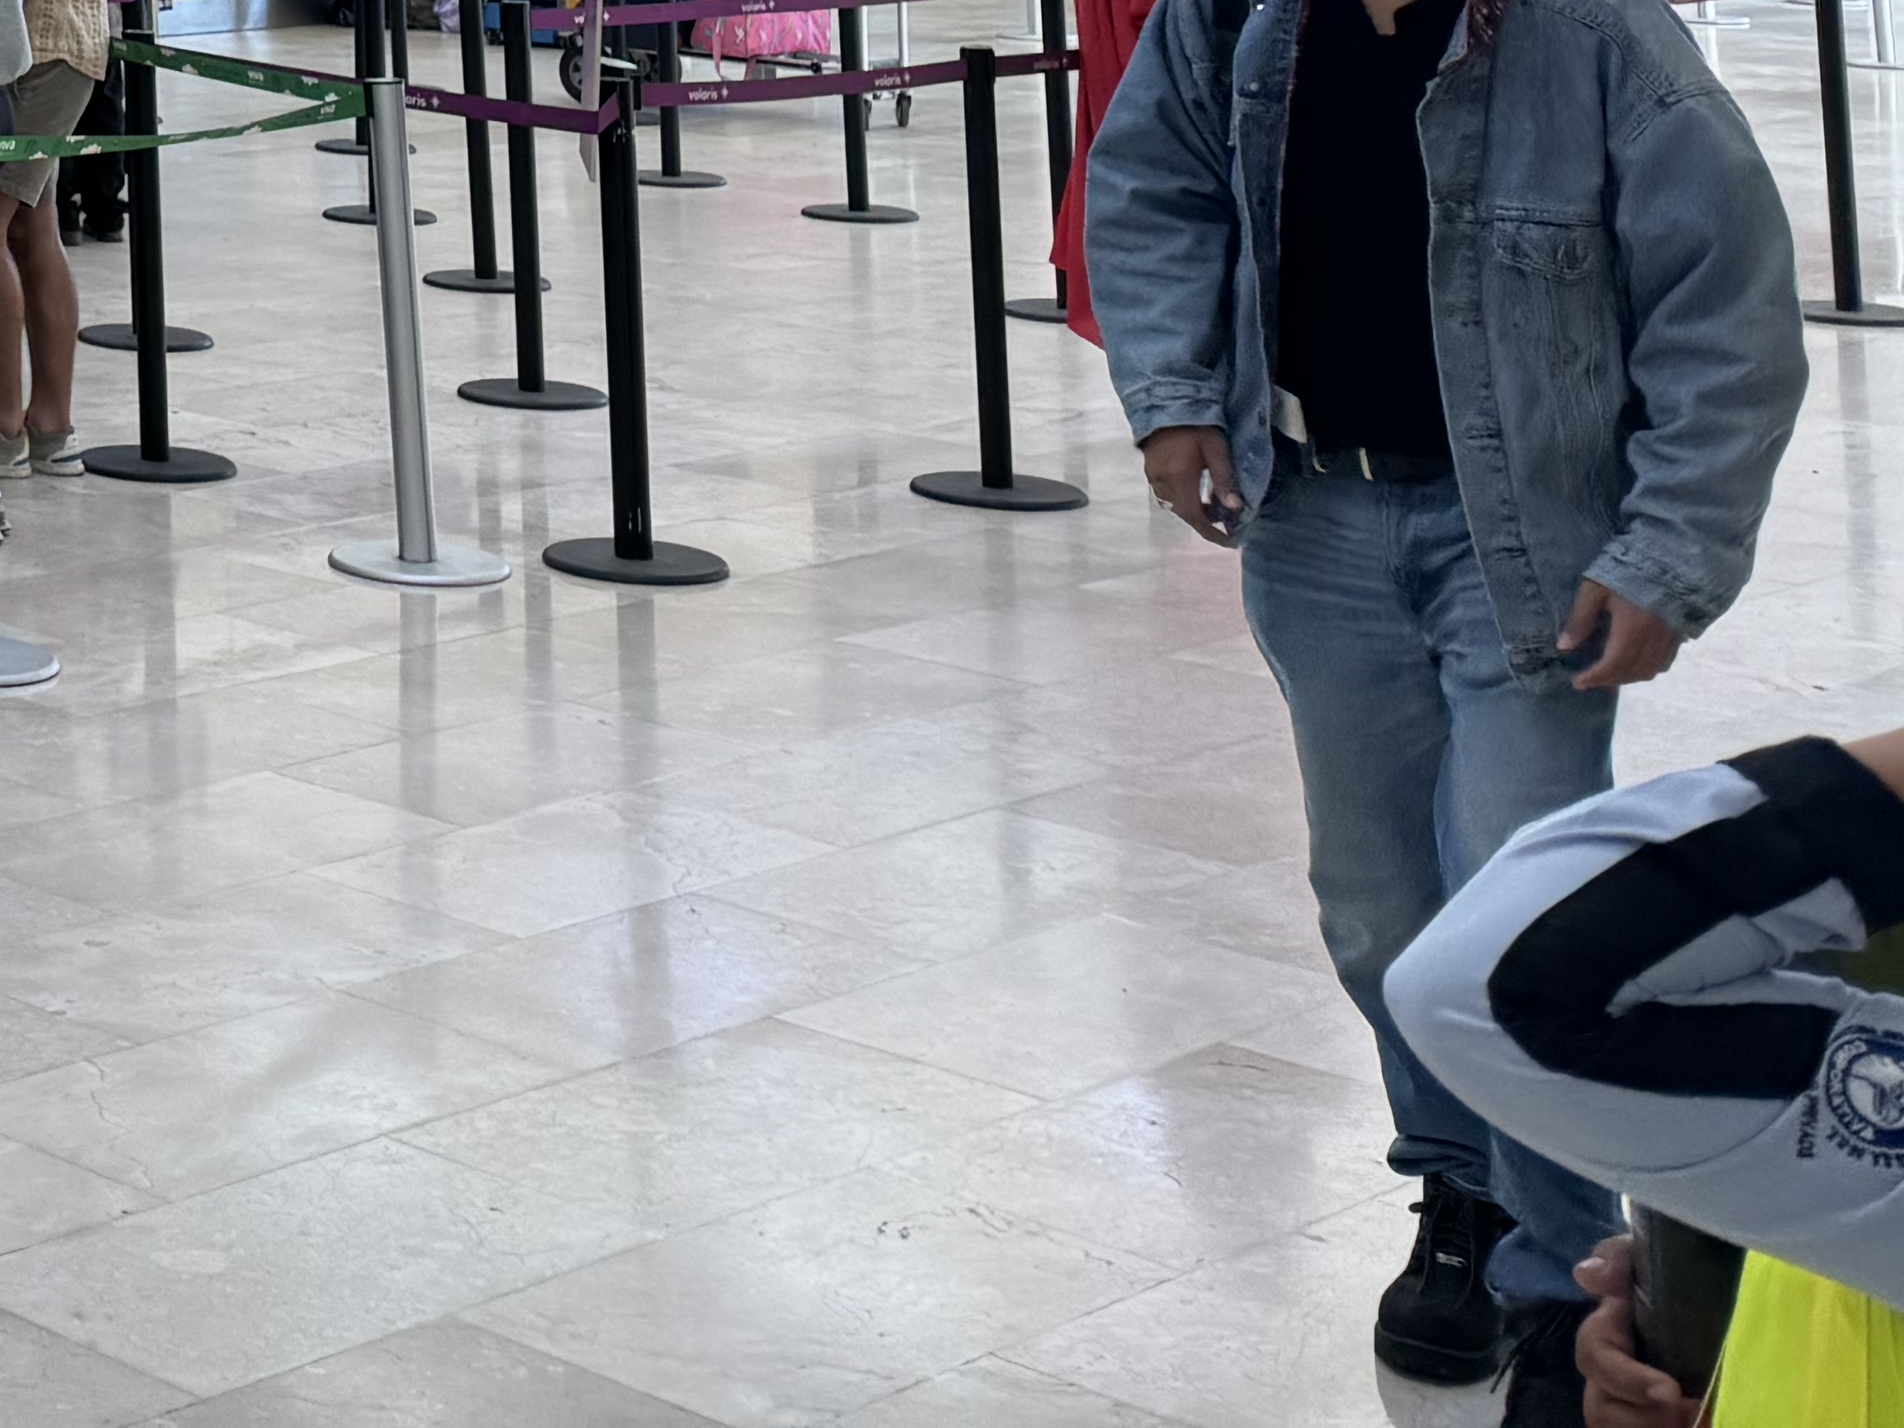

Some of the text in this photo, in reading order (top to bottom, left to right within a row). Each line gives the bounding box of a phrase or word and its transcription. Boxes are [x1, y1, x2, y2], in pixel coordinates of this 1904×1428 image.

[741, 0, 766, 13] volaris
[874, 76, 902, 87] volaris
[405, 95, 427, 107] aris
[688, 88, 718, 102] volaris
